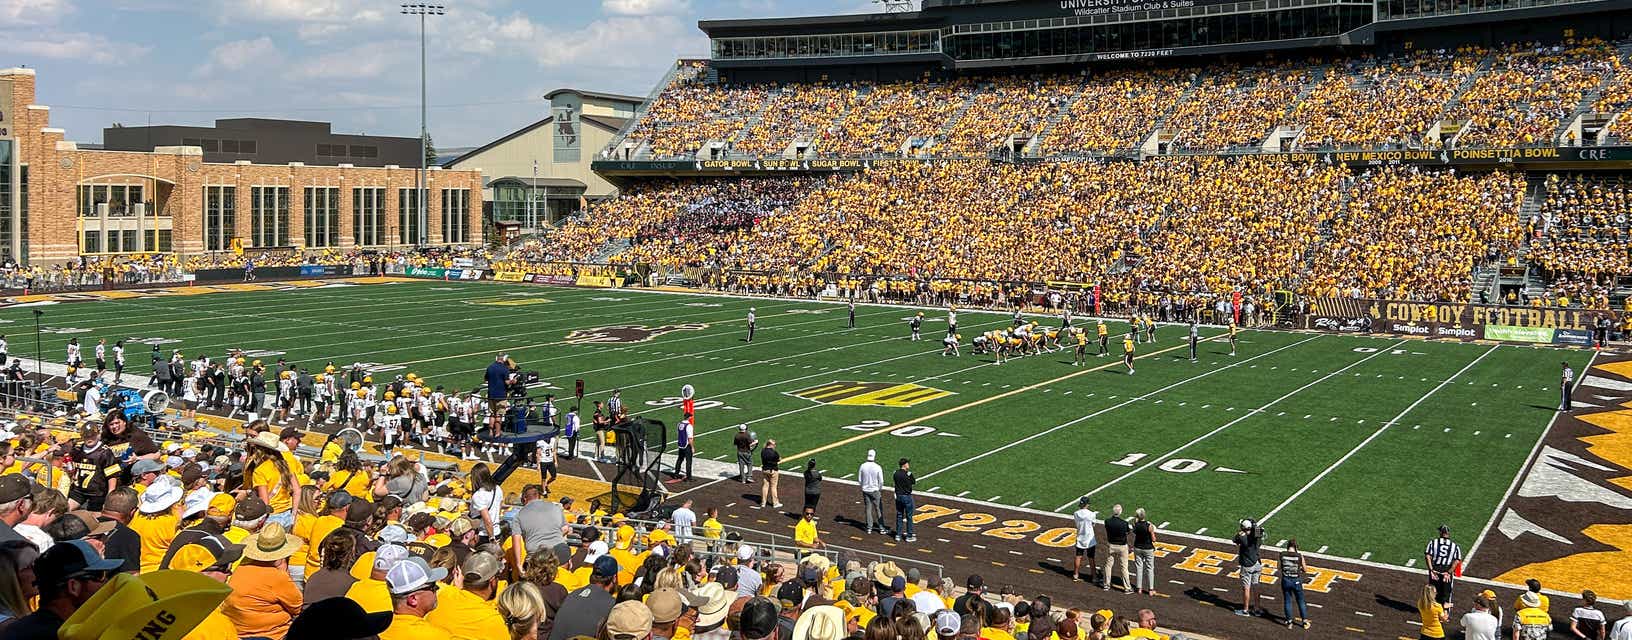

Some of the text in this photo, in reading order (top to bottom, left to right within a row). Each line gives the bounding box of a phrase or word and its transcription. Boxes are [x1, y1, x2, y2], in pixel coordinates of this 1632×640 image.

[1074, 0, 1194, 16] Wildcatter Stadium Club & Suites
[1096, 52, 1129, 60] WELCOME
[1291, 153, 1317, 162] BOWL
[1336, 151, 1436, 161] NEW MEXICO BOWL
[1453, 148, 1560, 159] POINSETTIA BOWL
[704, 160, 752, 168] GATOR BOWL
[763, 160, 800, 168] SUN BOWL
[811, 160, 861, 168] SUGAR BOWL
[1472, 306, 1587, 331] FOOTBALL
[1393, 323, 1430, 334] Simplot
[1438, 325, 1476, 337] Simplot
[389, 419, 398, 429] 57
[842, 420, 937, 437] 20
[1108, 452, 1209, 473] 10
[911, 504, 1077, 548] 7220
[1438, 545, 1448, 558] S
[1128, 541, 1364, 594] FEET
